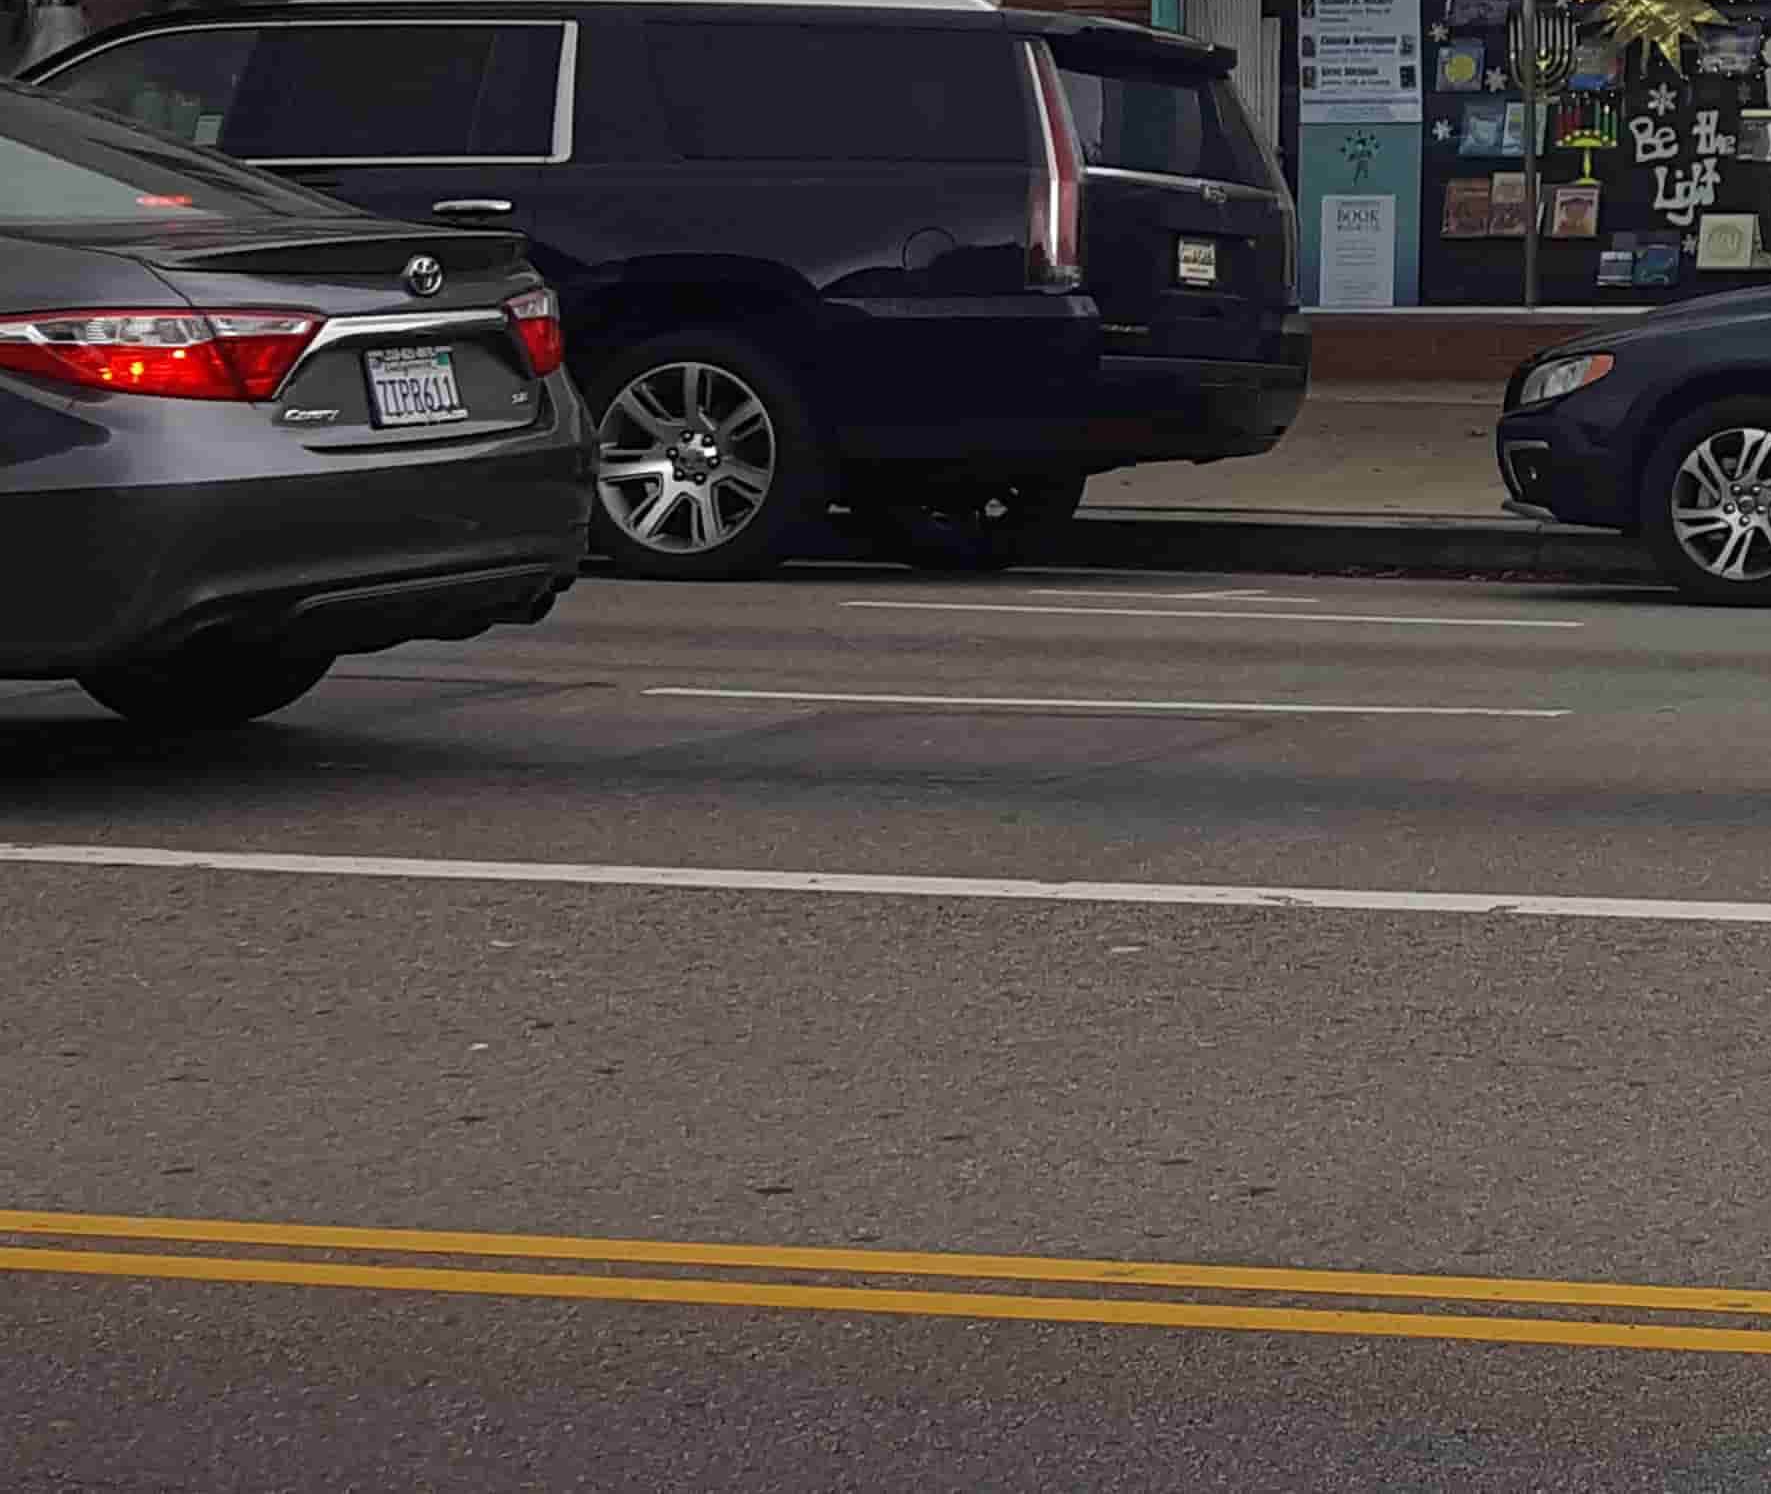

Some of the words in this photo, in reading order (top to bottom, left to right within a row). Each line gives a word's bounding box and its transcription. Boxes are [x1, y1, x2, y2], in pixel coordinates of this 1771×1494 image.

[1629, 115, 1679, 162] Be
[1692, 110, 1737, 154] the
[1653, 157, 1720, 226] Light
